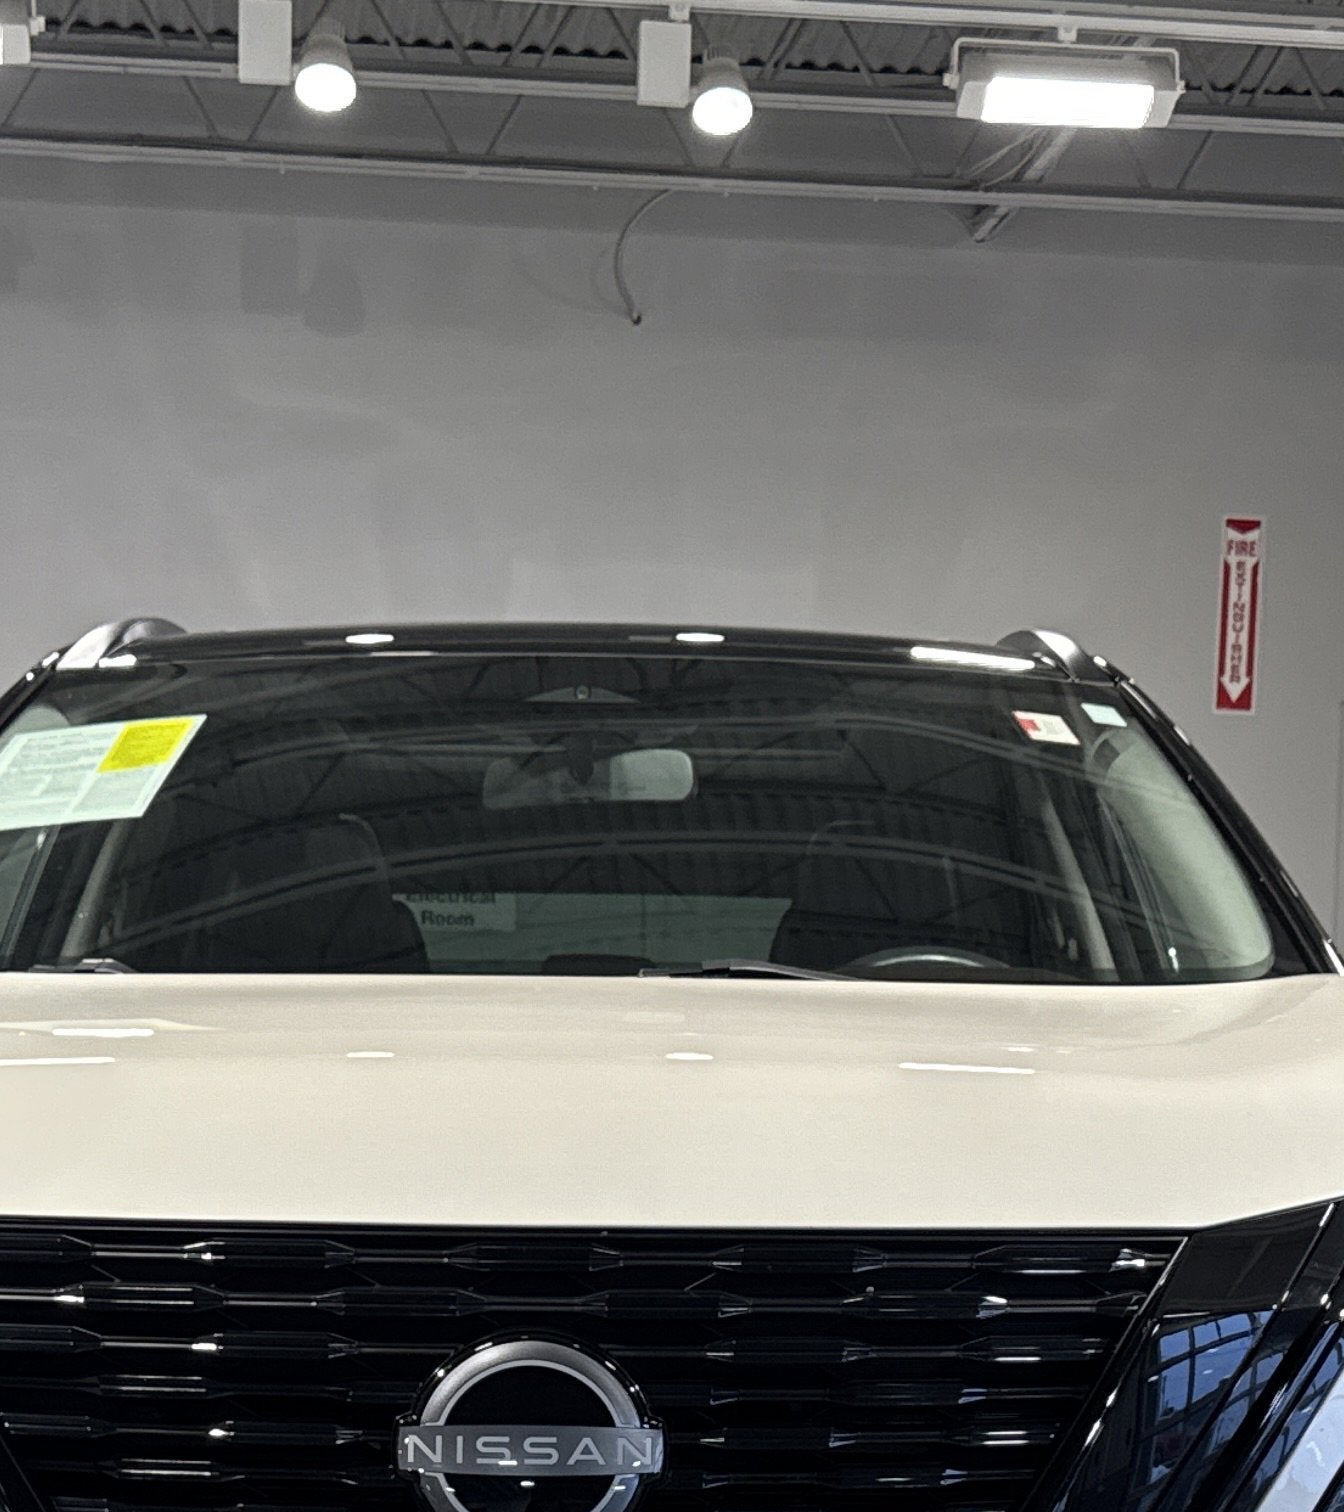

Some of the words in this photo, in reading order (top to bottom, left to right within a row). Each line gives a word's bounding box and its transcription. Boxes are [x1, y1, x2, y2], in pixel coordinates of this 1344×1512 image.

[1226, 540, 1256, 557] FIRE
[1229, 561, 1247, 684] EXTINGUISHER
[421, 910, 476, 927] Room
[407, 1434, 652, 1466] NISSAN
